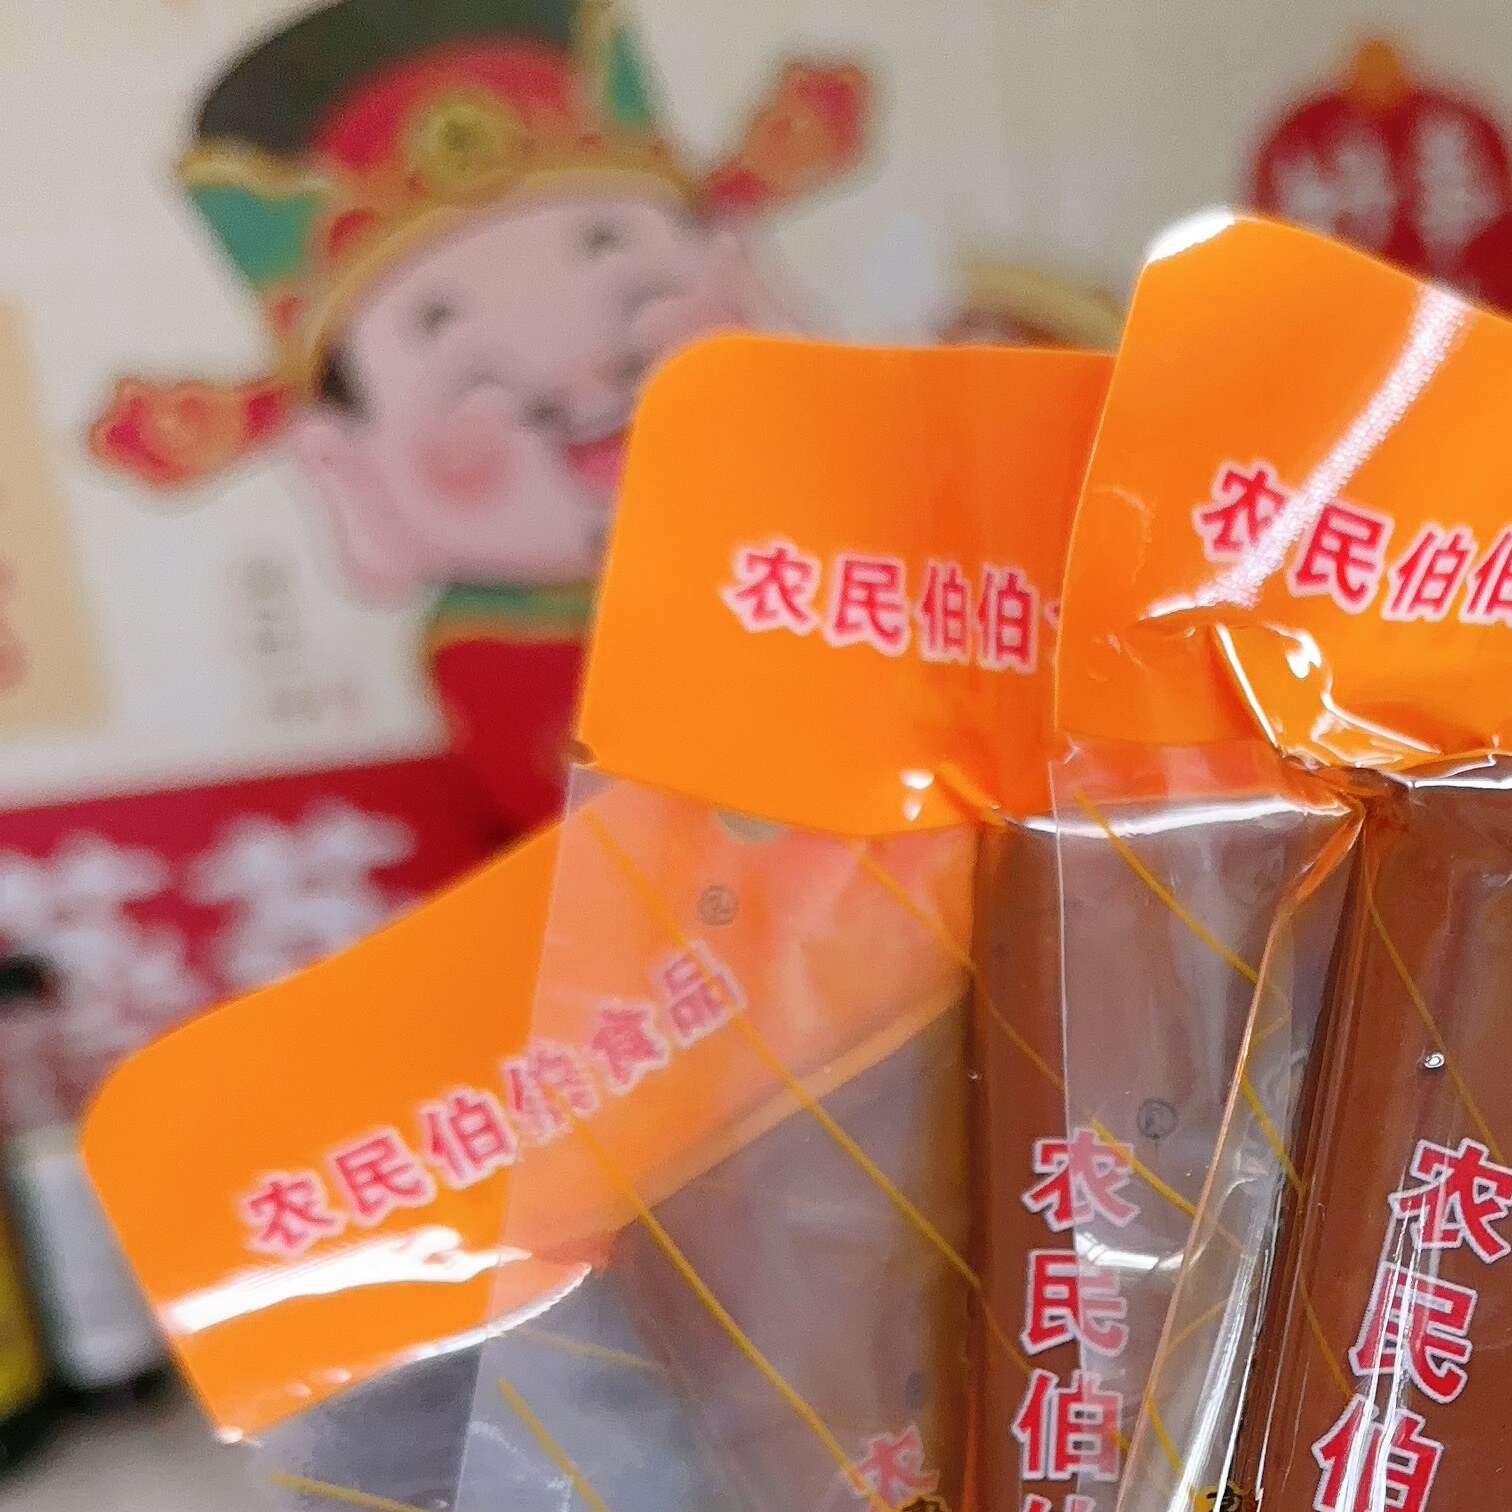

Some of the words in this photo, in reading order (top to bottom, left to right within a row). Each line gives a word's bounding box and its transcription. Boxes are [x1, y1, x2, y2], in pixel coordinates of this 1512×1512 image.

[722, 538, 1060, 673] 农民伯伯
[240, 940, 748, 1256] 农民伯伯食品
